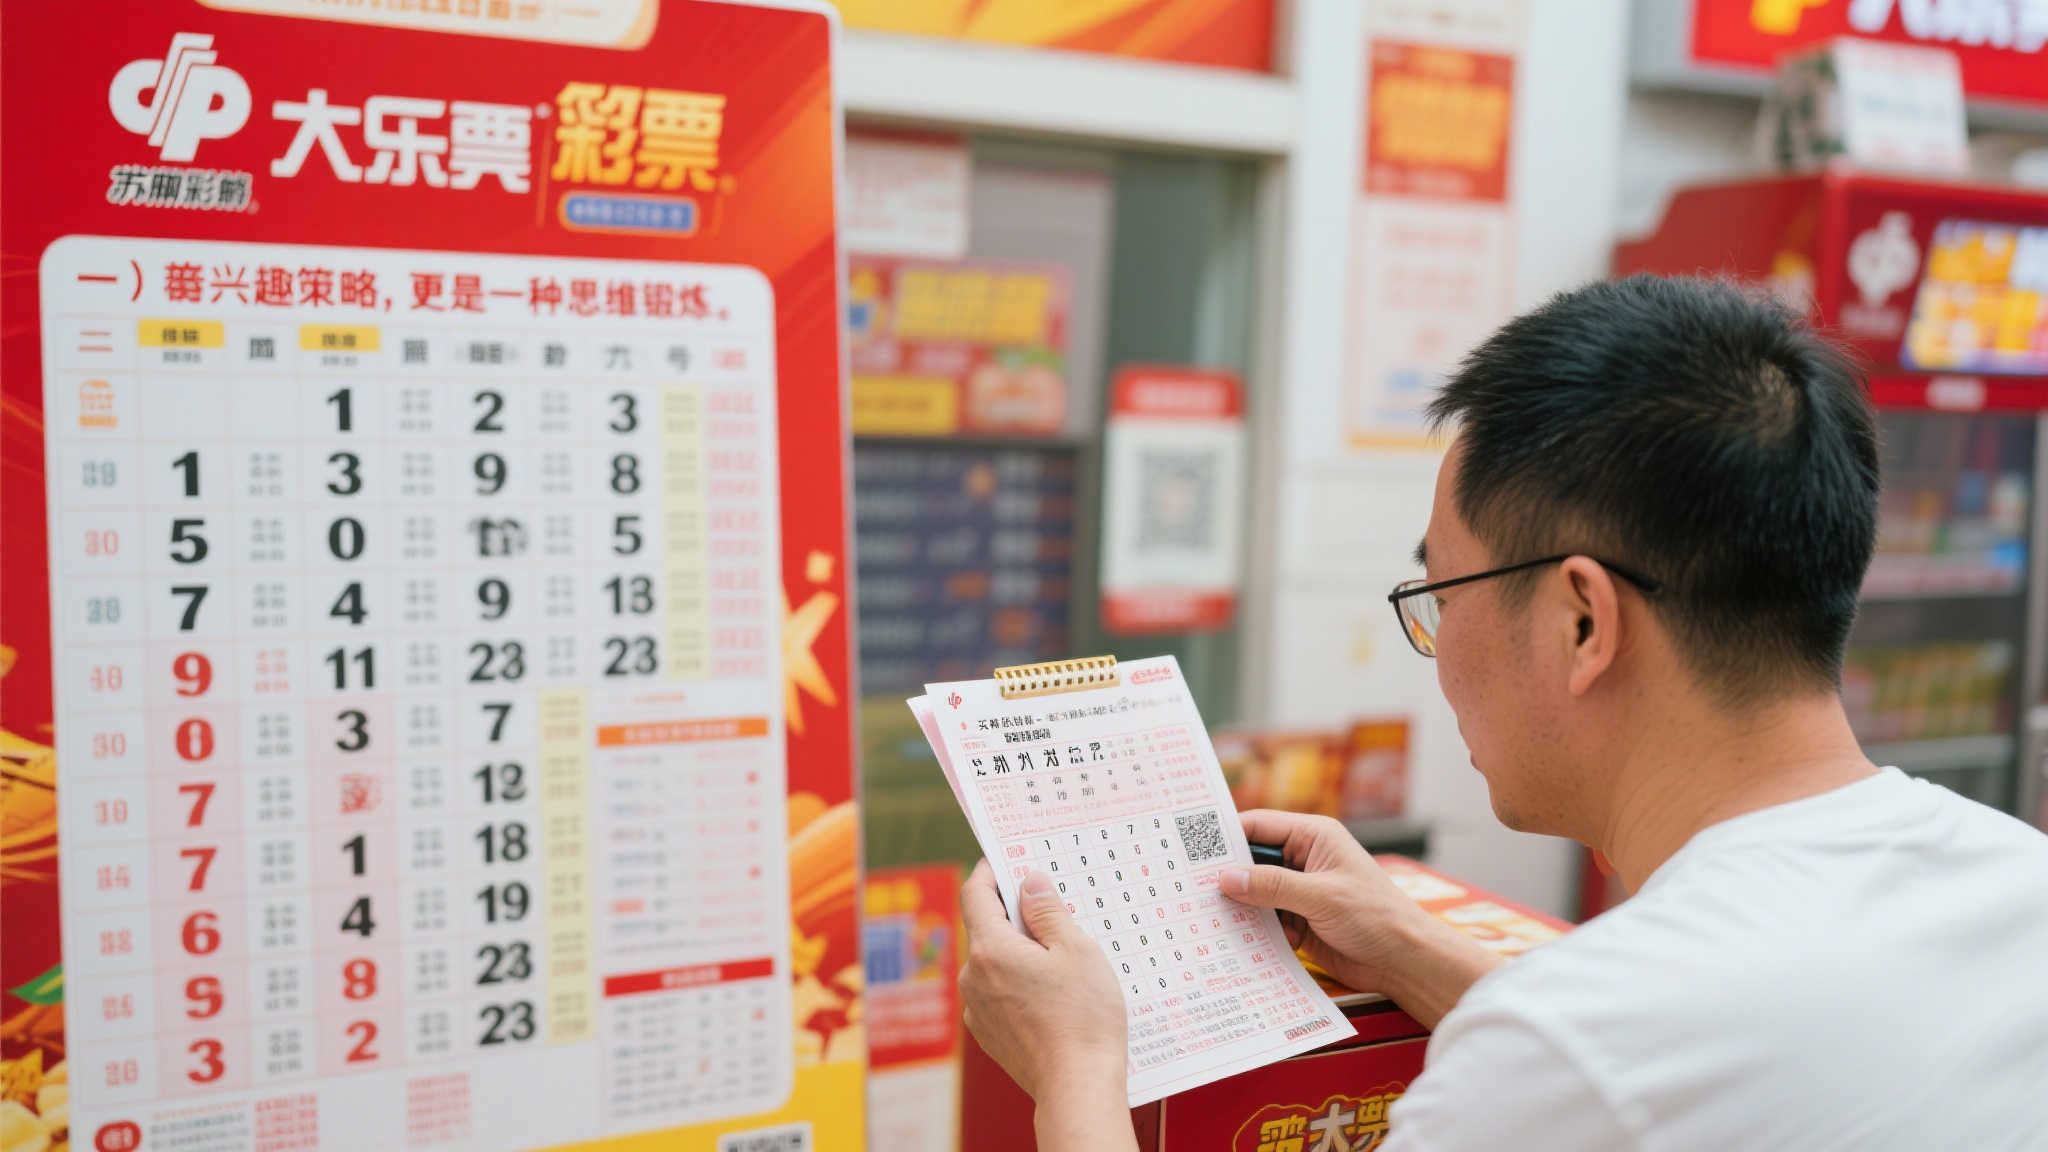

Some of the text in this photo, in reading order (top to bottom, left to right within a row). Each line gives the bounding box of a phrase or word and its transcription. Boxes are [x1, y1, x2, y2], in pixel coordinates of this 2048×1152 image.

[321, 389, 641, 432] 1 2 3
[168, 452, 203, 497] 1
[323, 453, 366, 496] 3
[470, 454, 510, 494] 9
[605, 455, 646, 494] 8
[168, 518, 212, 564] 5
[324, 518, 369, 561] 0
[611, 516, 646, 554] 5
[168, 586, 212, 631] 7
[325, 583, 371, 625] 4
[474, 579, 514, 618] 9
[171, 652, 214, 697] 9
[322, 647, 378, 690] 11
[332, 711, 373, 752] 3
[480, 703, 515, 742] 7
[178, 783, 217, 827] 7
[179, 822, 530, 892] 7 1 18
[180, 881, 532, 956] 6 4 19
[342, 959, 379, 1001] 8
[187, 1039, 227, 1083] 3
[345, 1020, 380, 1063] 2
[477, 1001, 539, 1047] 23
